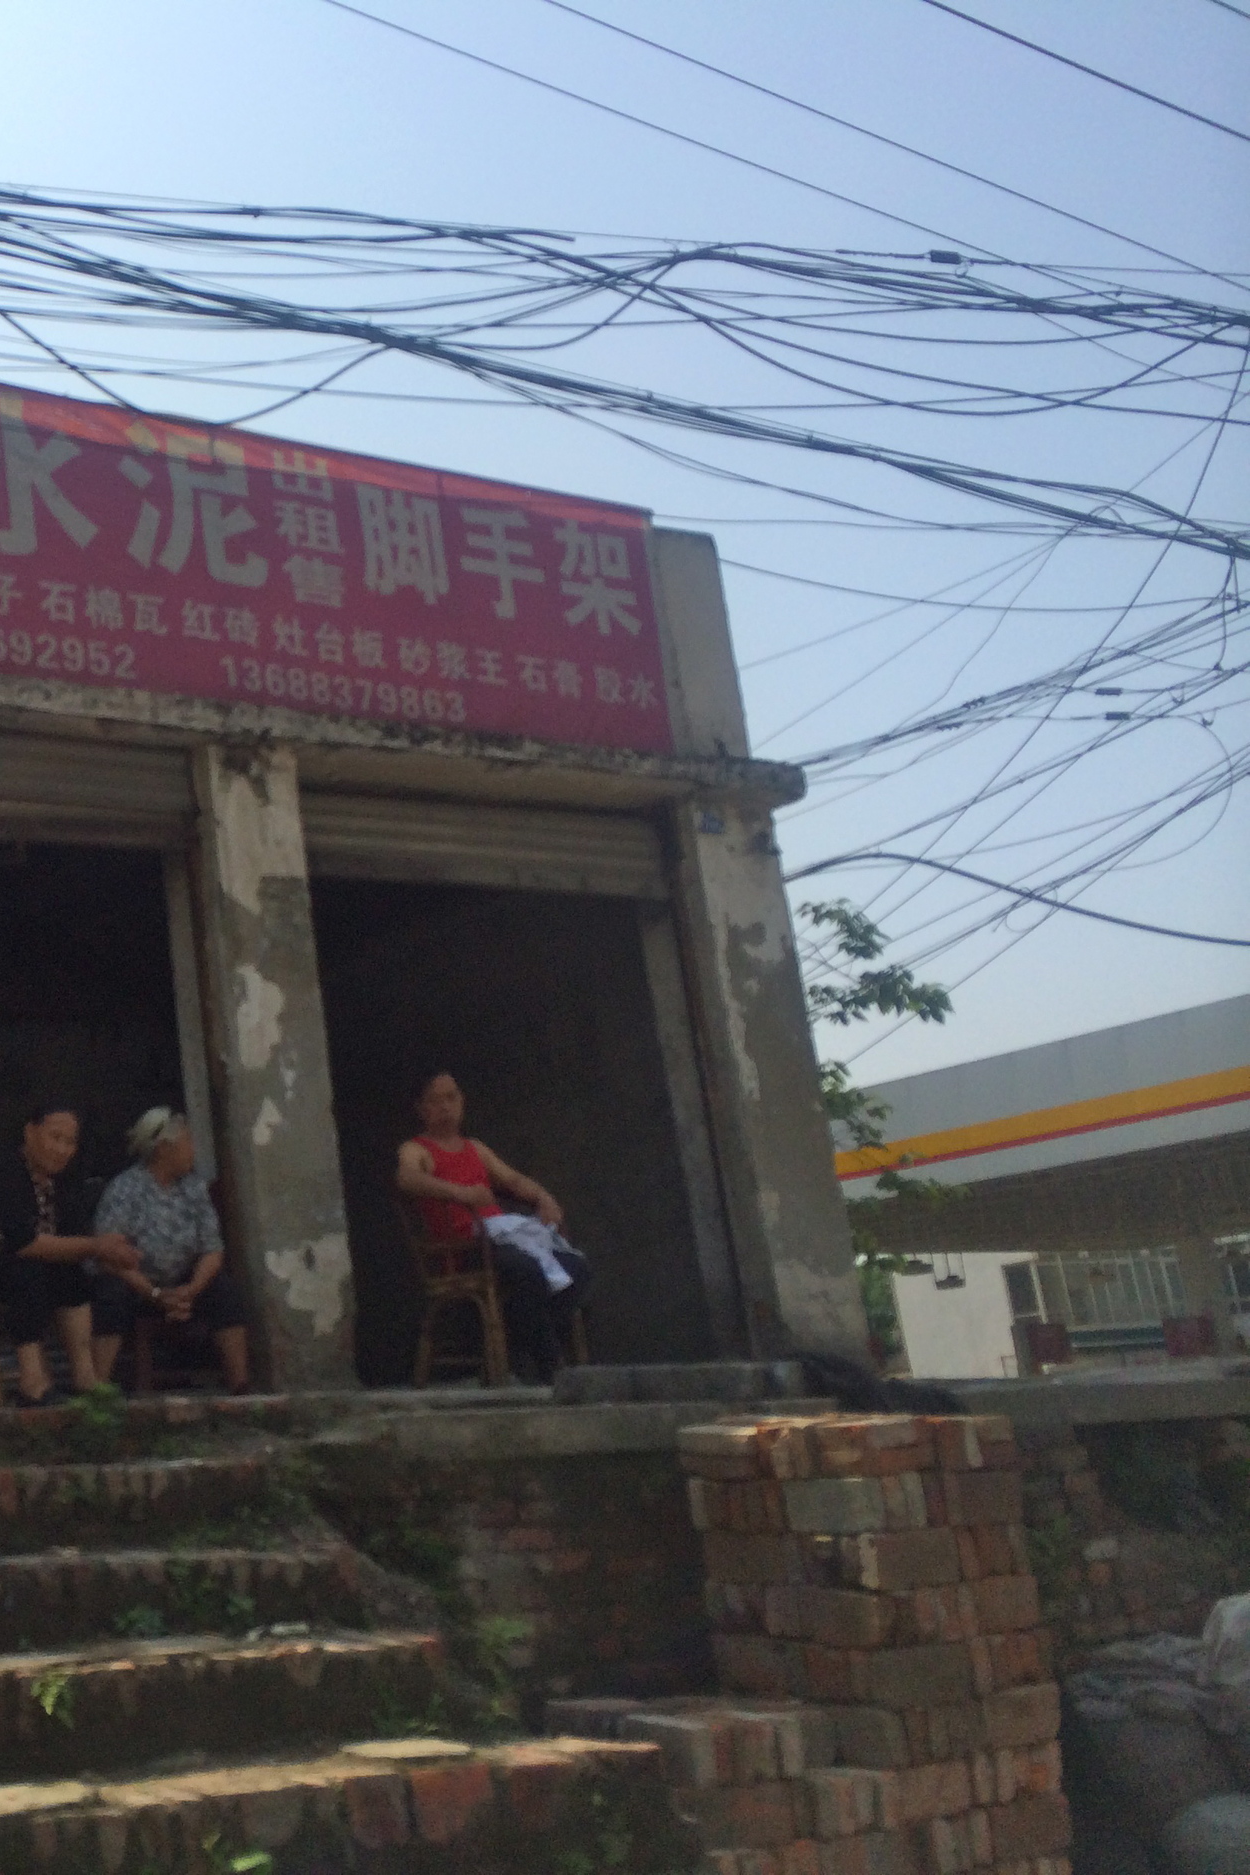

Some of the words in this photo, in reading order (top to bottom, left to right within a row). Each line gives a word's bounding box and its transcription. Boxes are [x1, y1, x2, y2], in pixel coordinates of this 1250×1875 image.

[354, 482, 643, 637] 脚手架
[39, 579, 169, 637] 石棉瓦
[181, 598, 261, 649] 红砖
[218, 654, 467, 723] 13688379863
